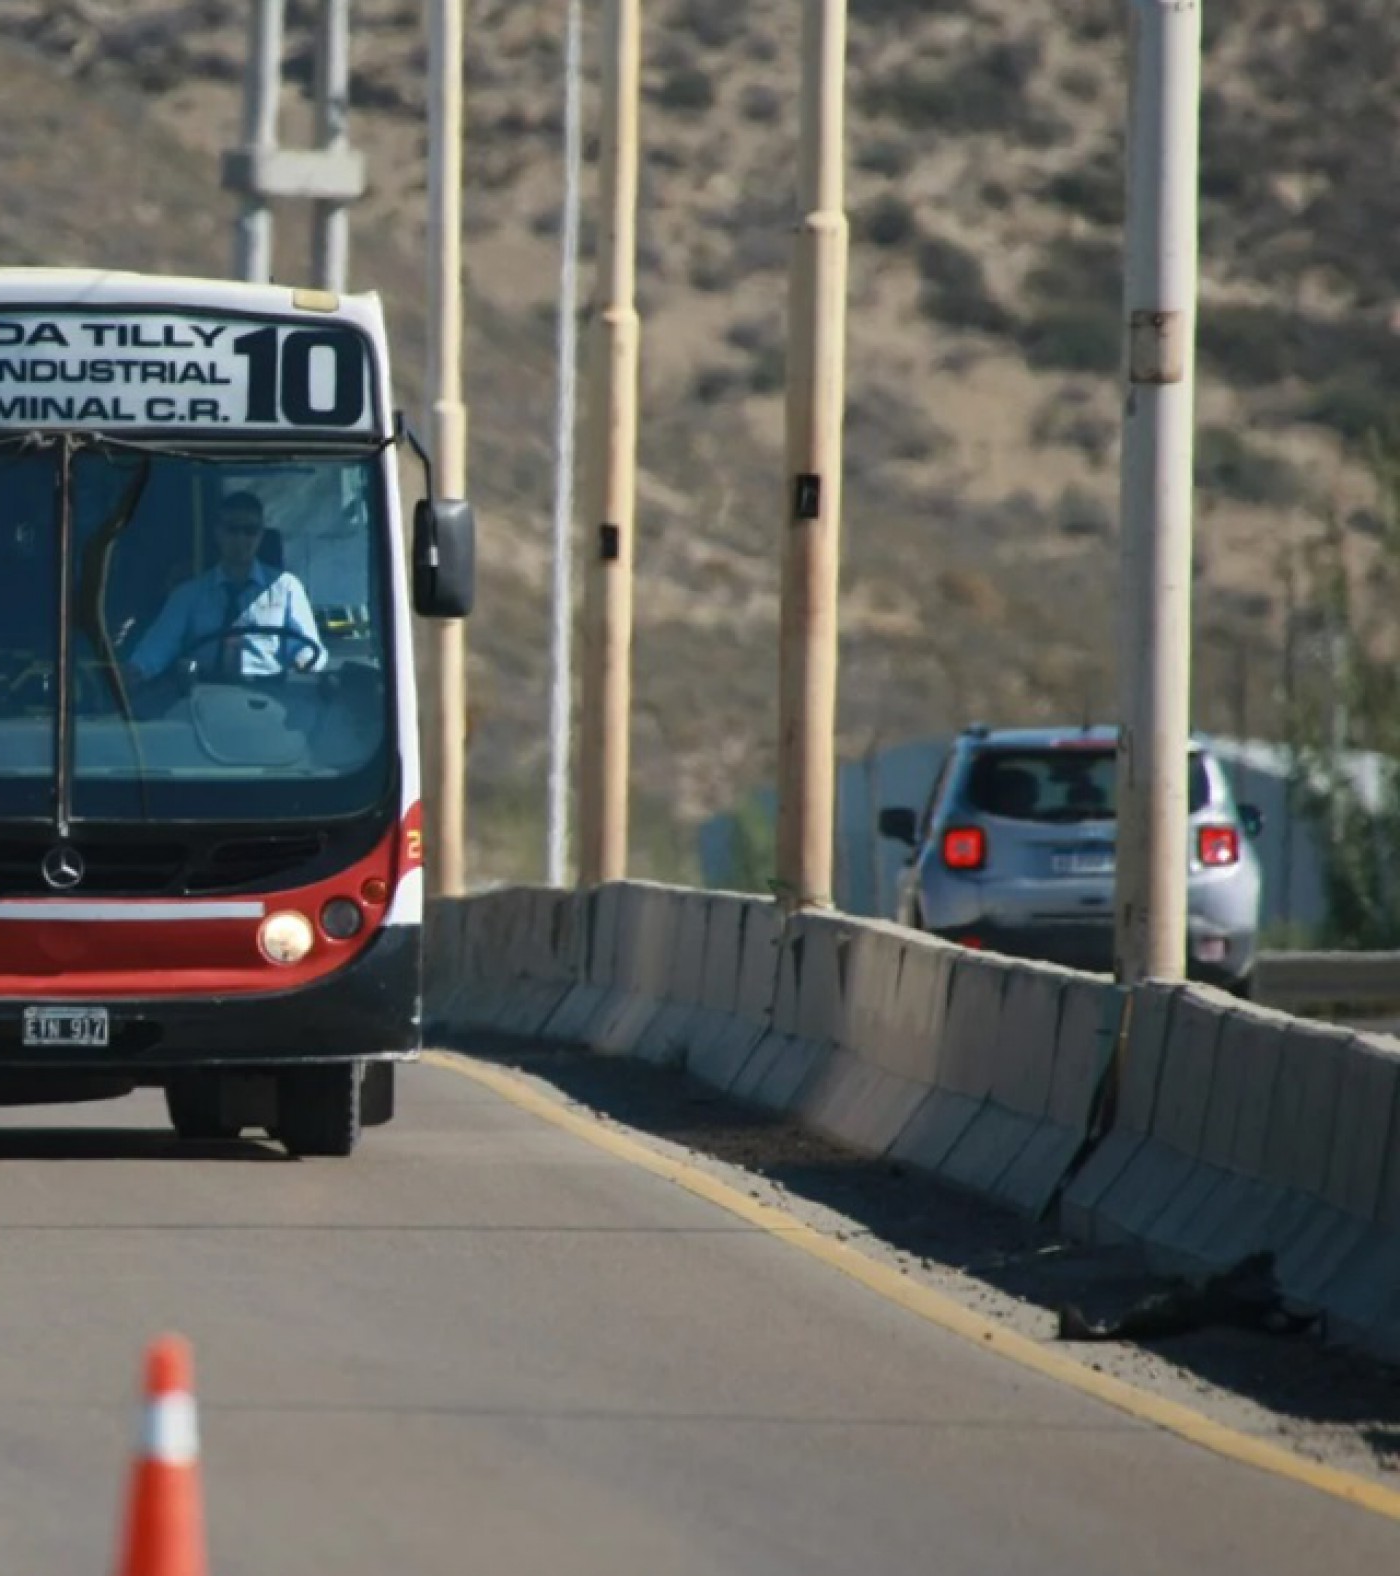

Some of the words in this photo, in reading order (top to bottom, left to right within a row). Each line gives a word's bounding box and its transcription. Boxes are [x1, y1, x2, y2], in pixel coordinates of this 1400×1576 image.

[81, 324, 227, 347] TILLY
[234, 326, 363, 426] 10
[146, 397, 230, 422] C.R.
